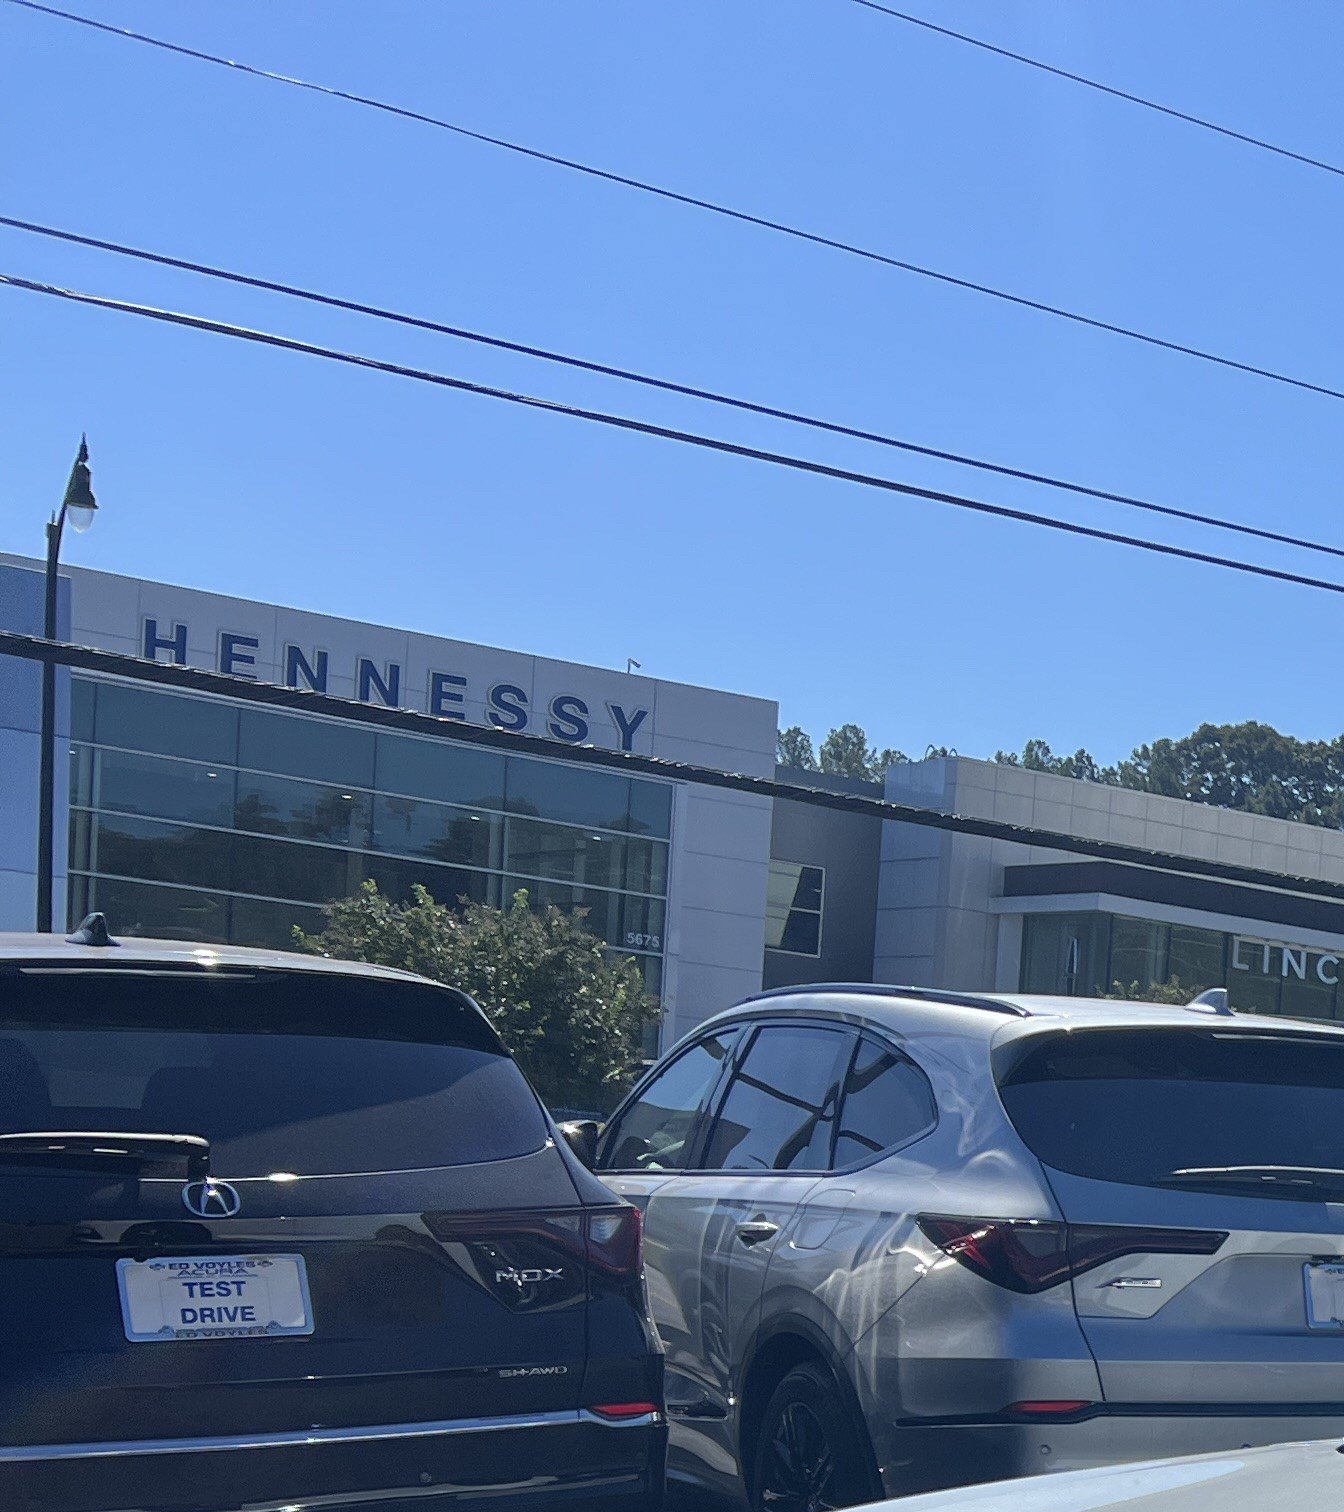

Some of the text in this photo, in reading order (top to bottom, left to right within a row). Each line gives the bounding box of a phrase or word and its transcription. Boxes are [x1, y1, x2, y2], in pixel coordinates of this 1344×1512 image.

[142, 617, 649, 751] HENNESSY
[168, 1262, 190, 1270] ED
[496, 1266, 563, 1283] MDX
[182, 1280, 247, 1299] TEST
[180, 1306, 257, 1324] DRIVE
